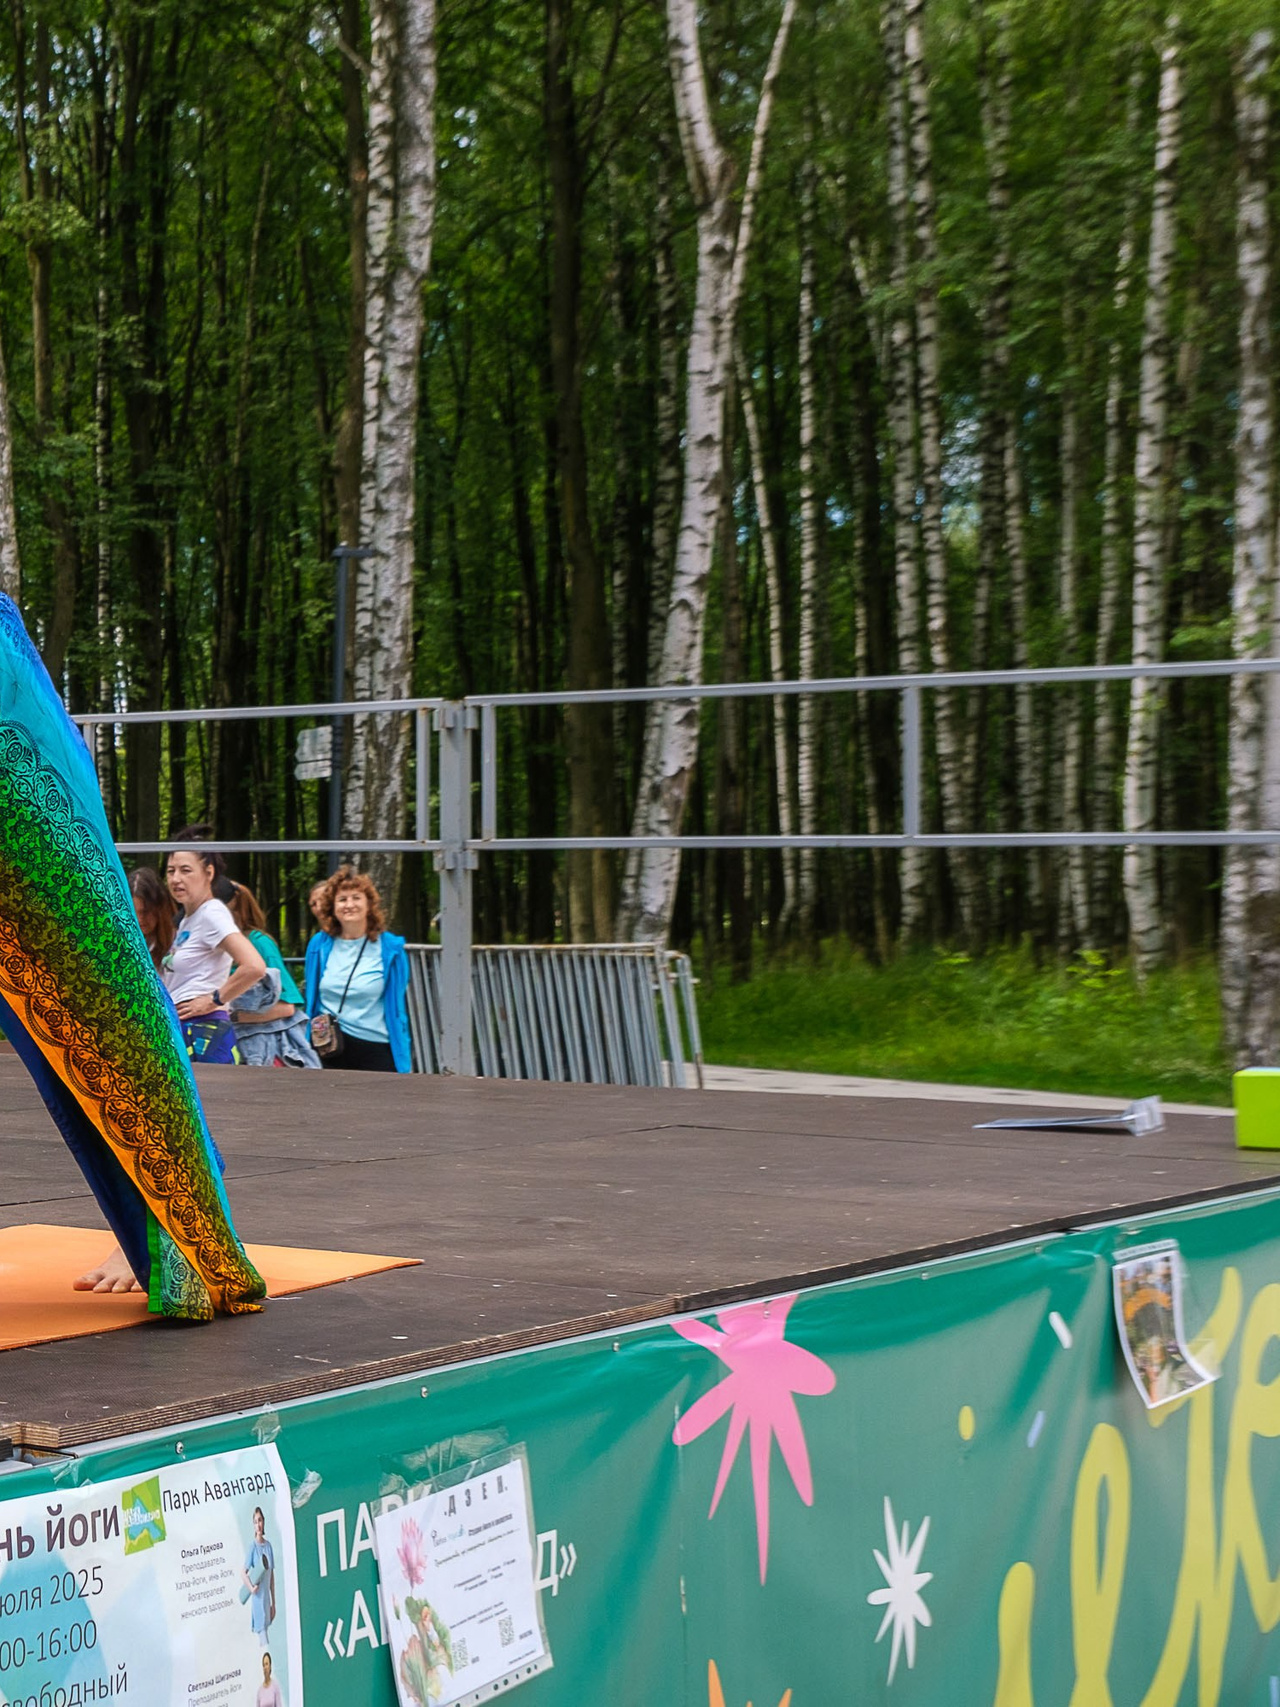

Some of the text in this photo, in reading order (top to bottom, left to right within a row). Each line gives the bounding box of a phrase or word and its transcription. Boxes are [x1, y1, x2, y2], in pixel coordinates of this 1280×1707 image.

[162, 1471, 275, 1513] Парк Авангард
[46, 1503, 120, 1553] йоги
[181, 1548, 199, 1558] Ольга
[50, 1565, 104, 1605] 2025
[2, 1663, 128, 1707] ободный
